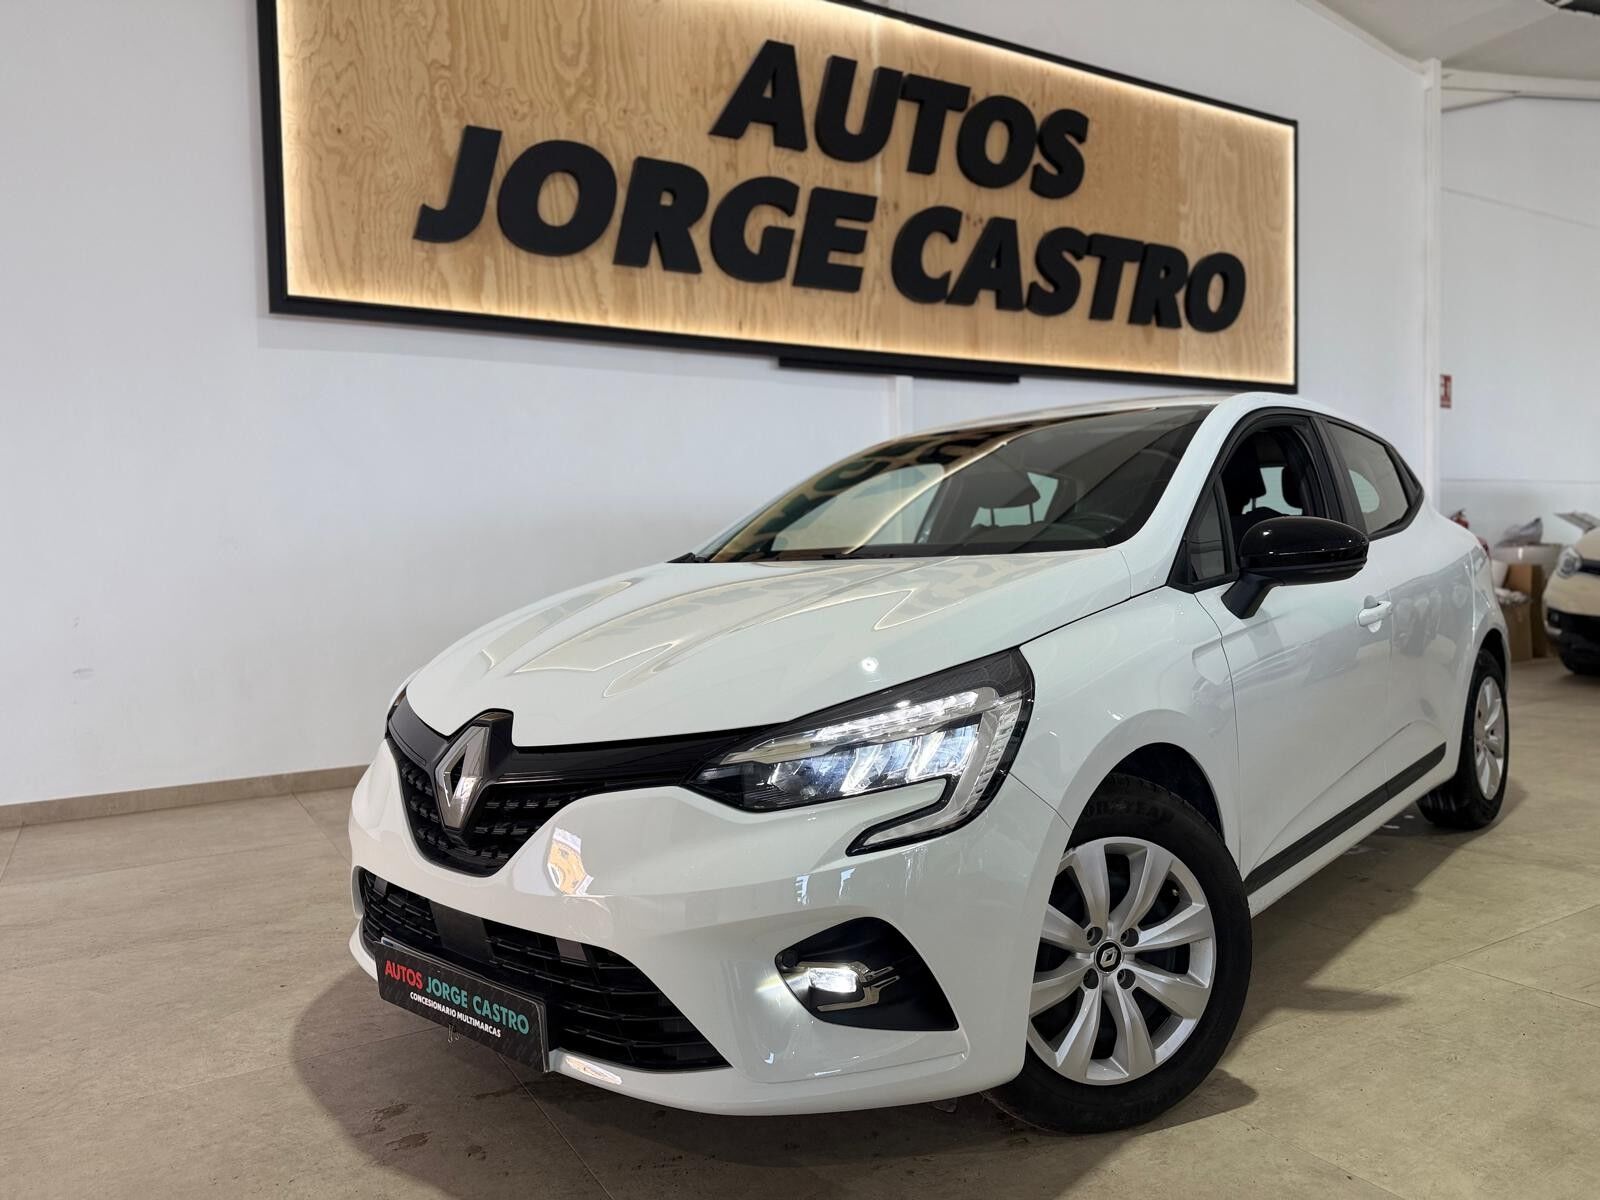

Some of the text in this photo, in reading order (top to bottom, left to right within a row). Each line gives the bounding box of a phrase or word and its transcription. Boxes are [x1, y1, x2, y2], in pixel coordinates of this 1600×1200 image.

[709, 40, 1089, 199] AUTOS
[414, 125, 1246, 332] JORGE CASTRO
[384, 960, 530, 1035] AUTOS JORGE CASTRO
[410, 991, 501, 1038] CONCESIONARIO MULTIMARCAS
